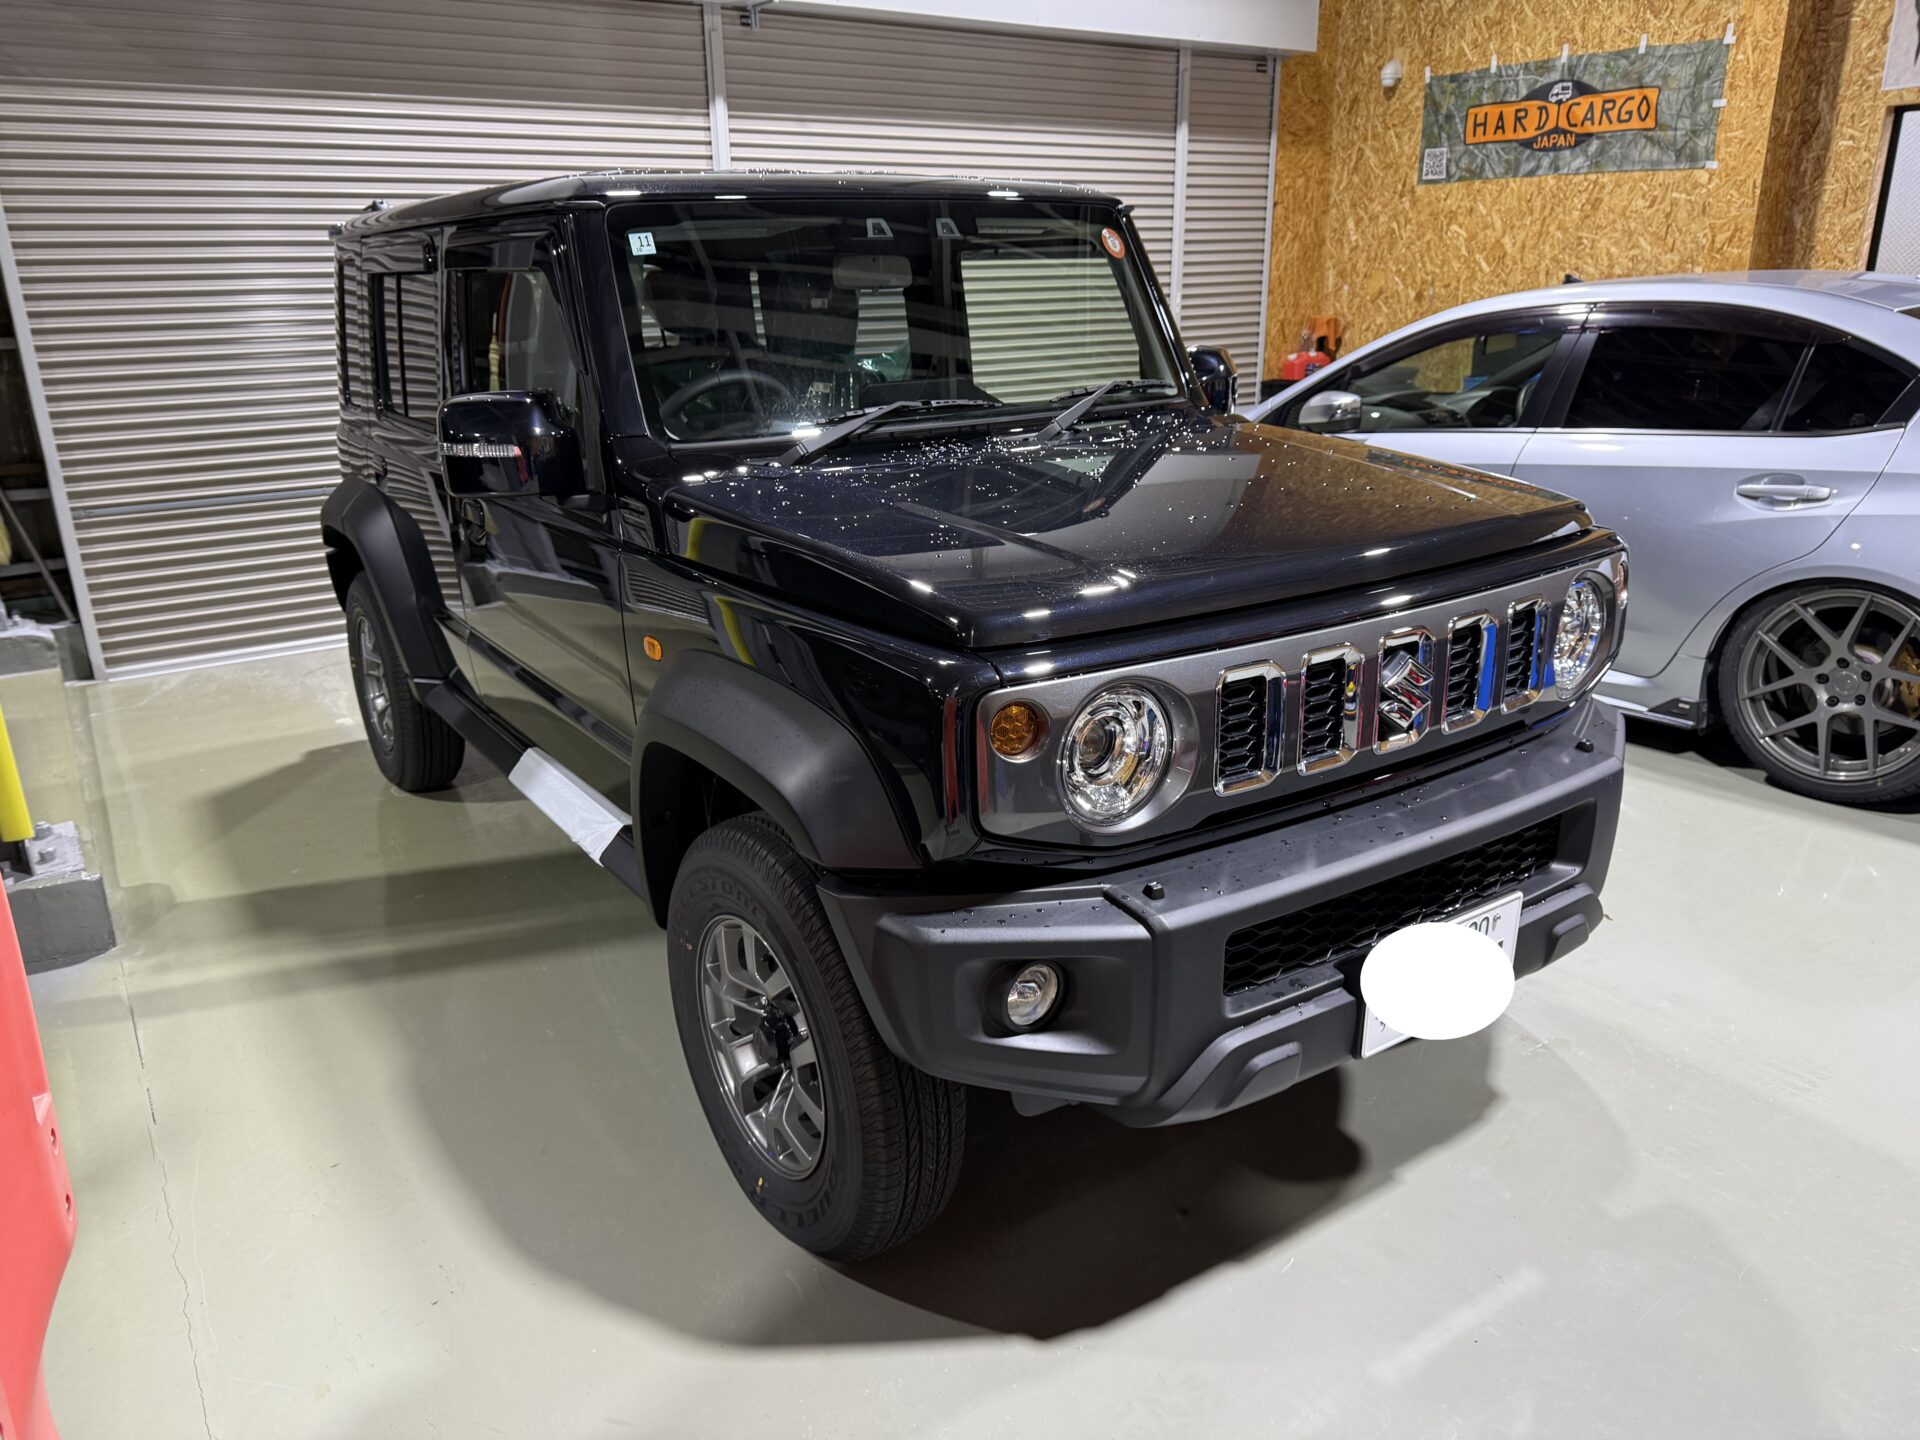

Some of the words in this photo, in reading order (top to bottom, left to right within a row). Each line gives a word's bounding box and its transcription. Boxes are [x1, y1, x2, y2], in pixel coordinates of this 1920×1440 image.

[1473, 105, 1549, 138] HARD
[1566, 95, 1651, 128] CARGO
[1533, 133, 1576, 149] JAPAN
[637, 235, 652, 247] 11
